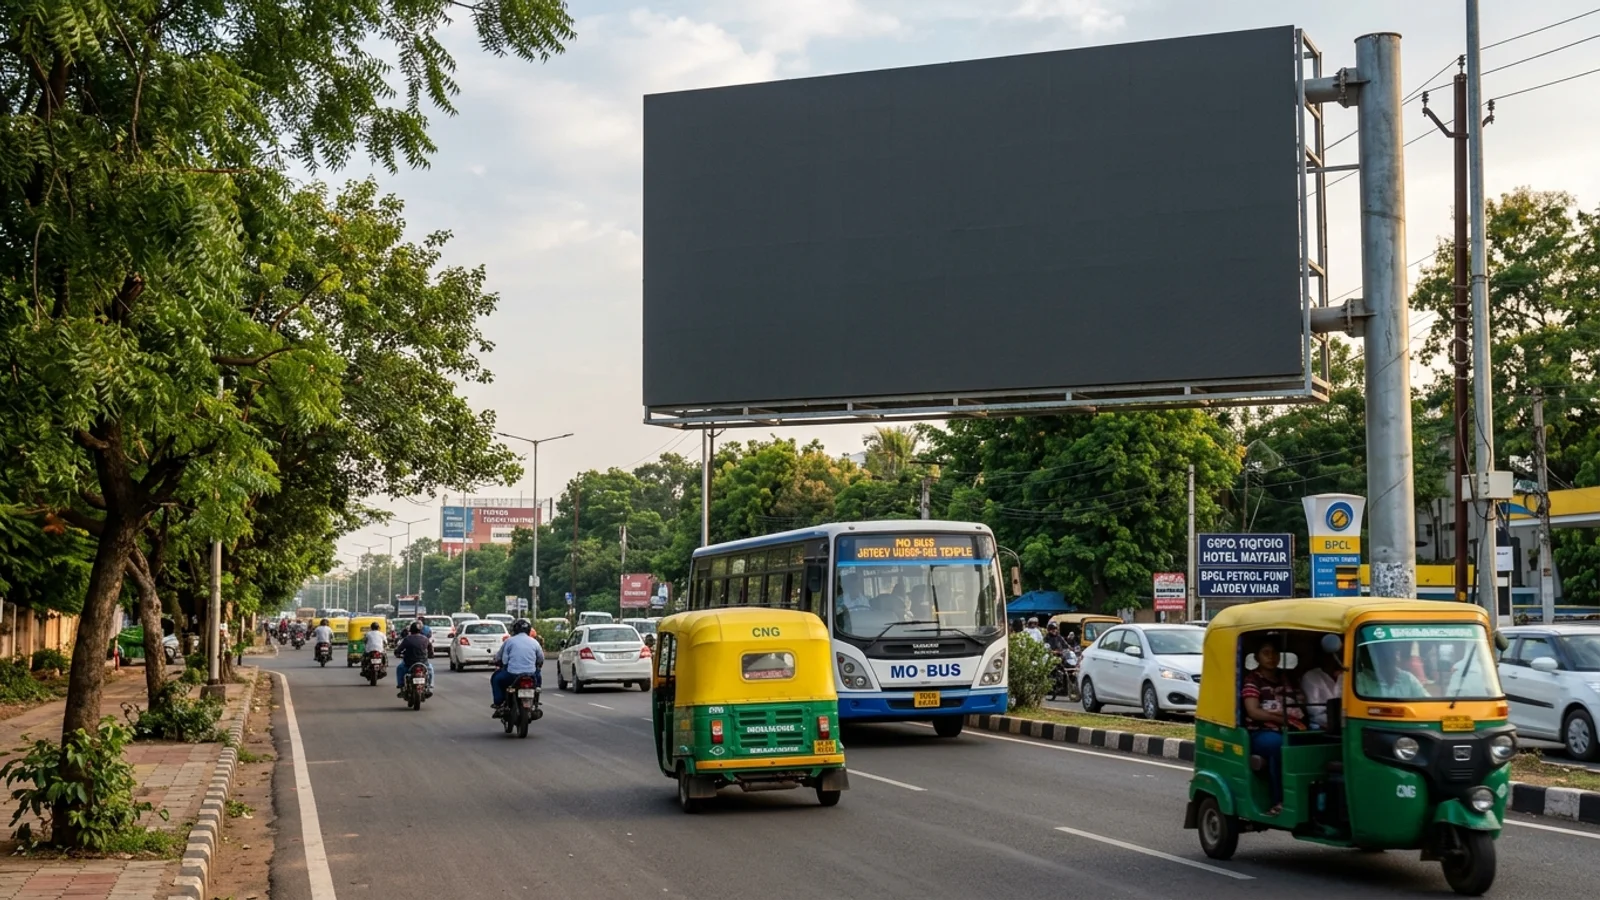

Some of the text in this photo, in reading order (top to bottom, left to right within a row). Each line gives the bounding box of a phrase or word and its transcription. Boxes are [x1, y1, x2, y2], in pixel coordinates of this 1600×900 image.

[1325, 540, 1351, 550] BPCL
[1203, 551, 1287, 563] HOTEL MAYFAIR
[1249, 583, 1280, 593] VIHAR
[752, 627, 780, 637] CNG
[890, 663, 961, 679] MO BUS
